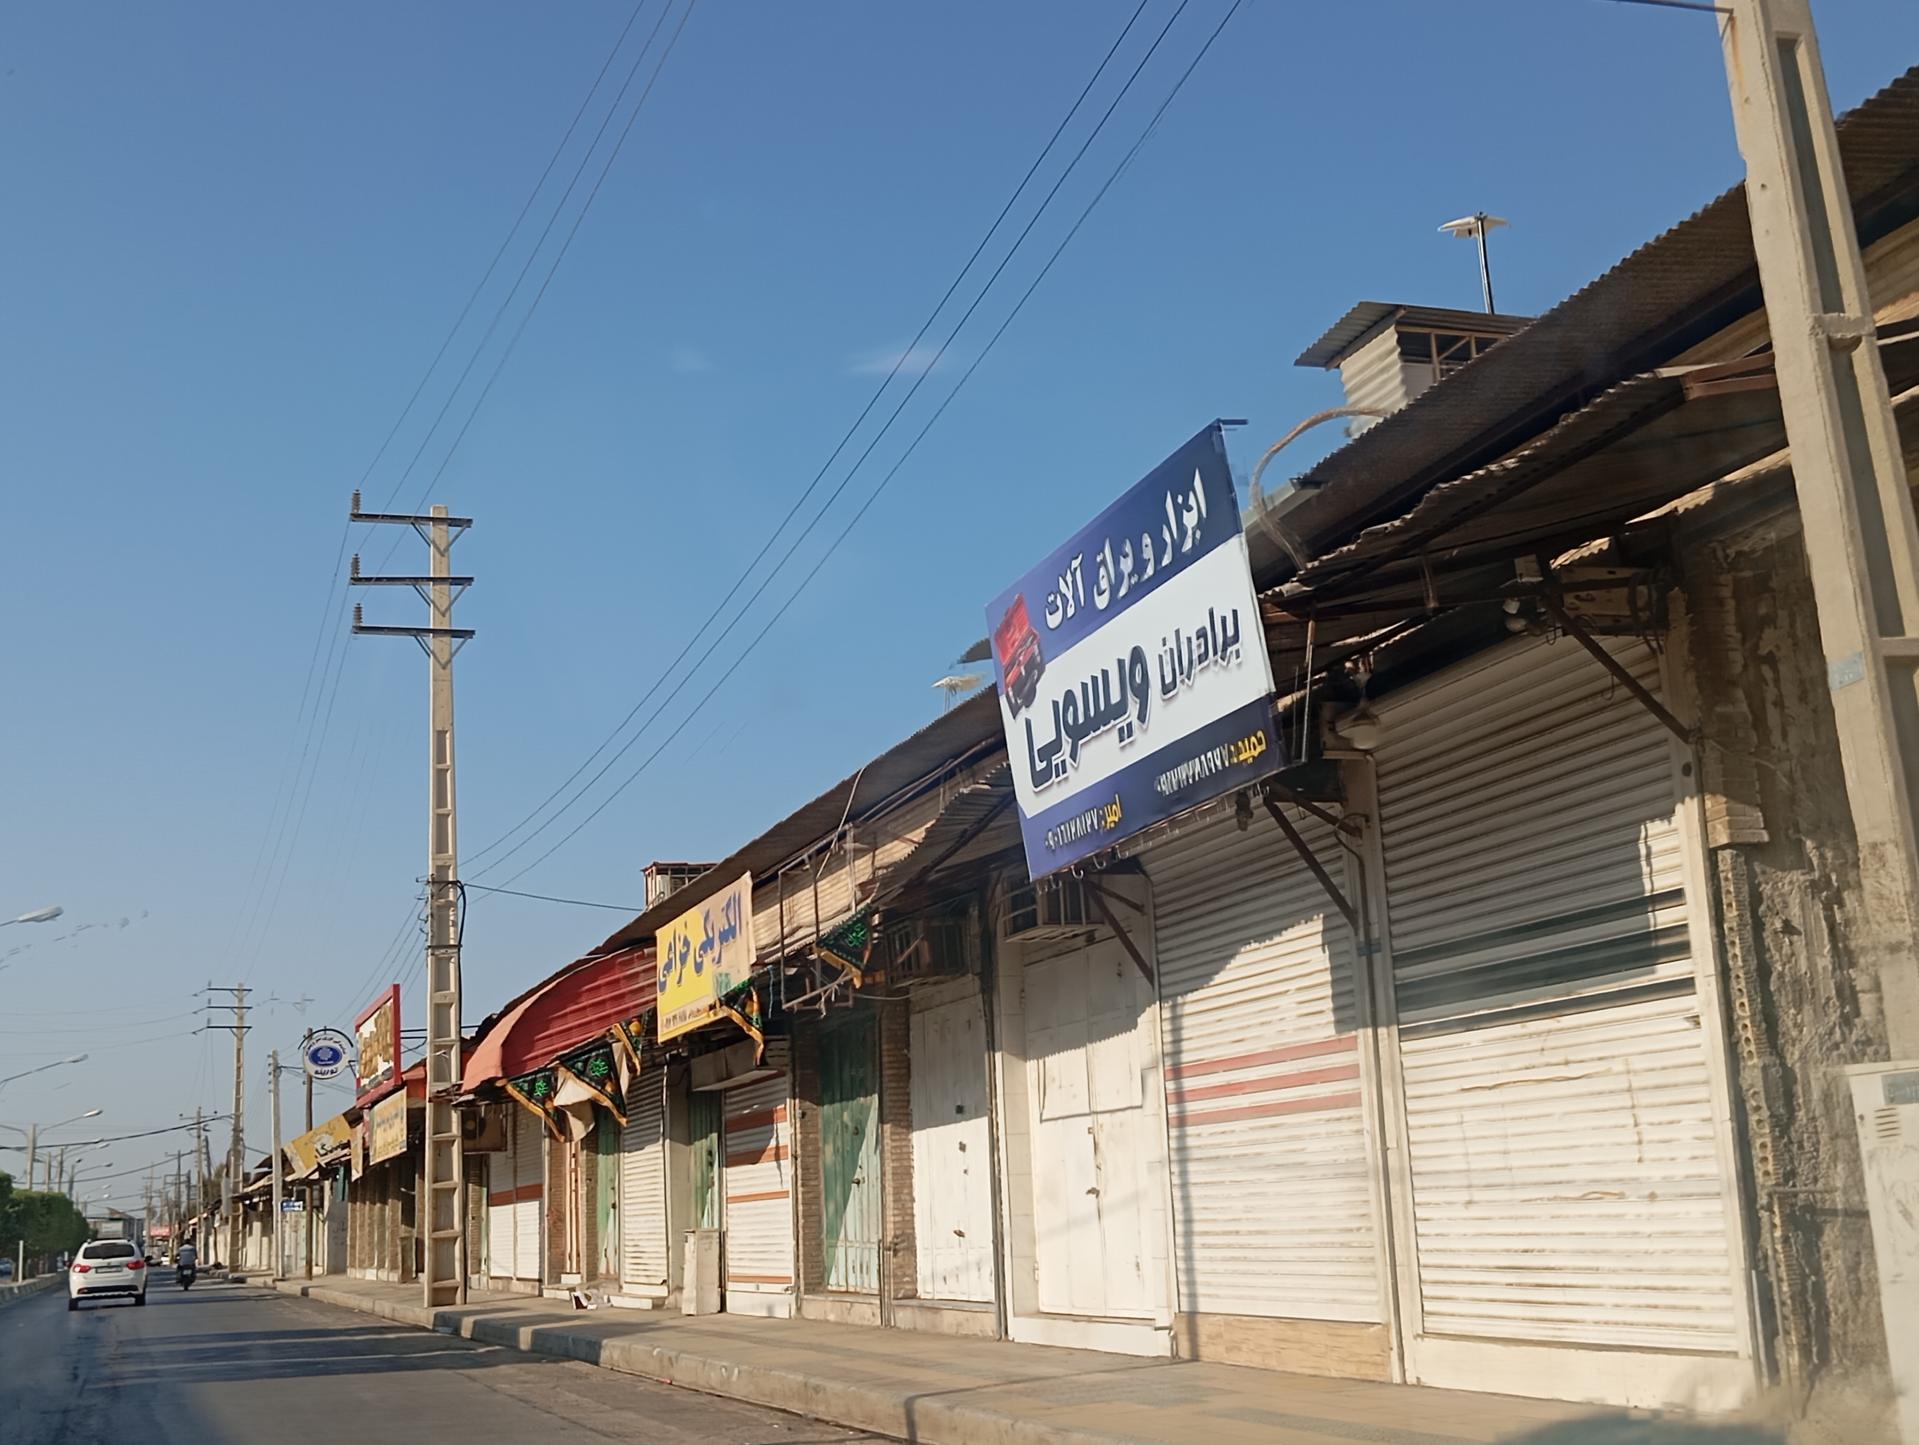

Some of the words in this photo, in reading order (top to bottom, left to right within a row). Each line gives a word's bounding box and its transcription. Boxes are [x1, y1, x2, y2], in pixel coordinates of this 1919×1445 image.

[1137, 532, 1155, 583] و
[1160, 467, 1207, 568] ابزار
[1045, 552, 1086, 630] آلات
[1093, 536, 1135, 611] یراق
[1158, 606, 1241, 698] برادران
[693, 890, 743, 976] الکتریکی
